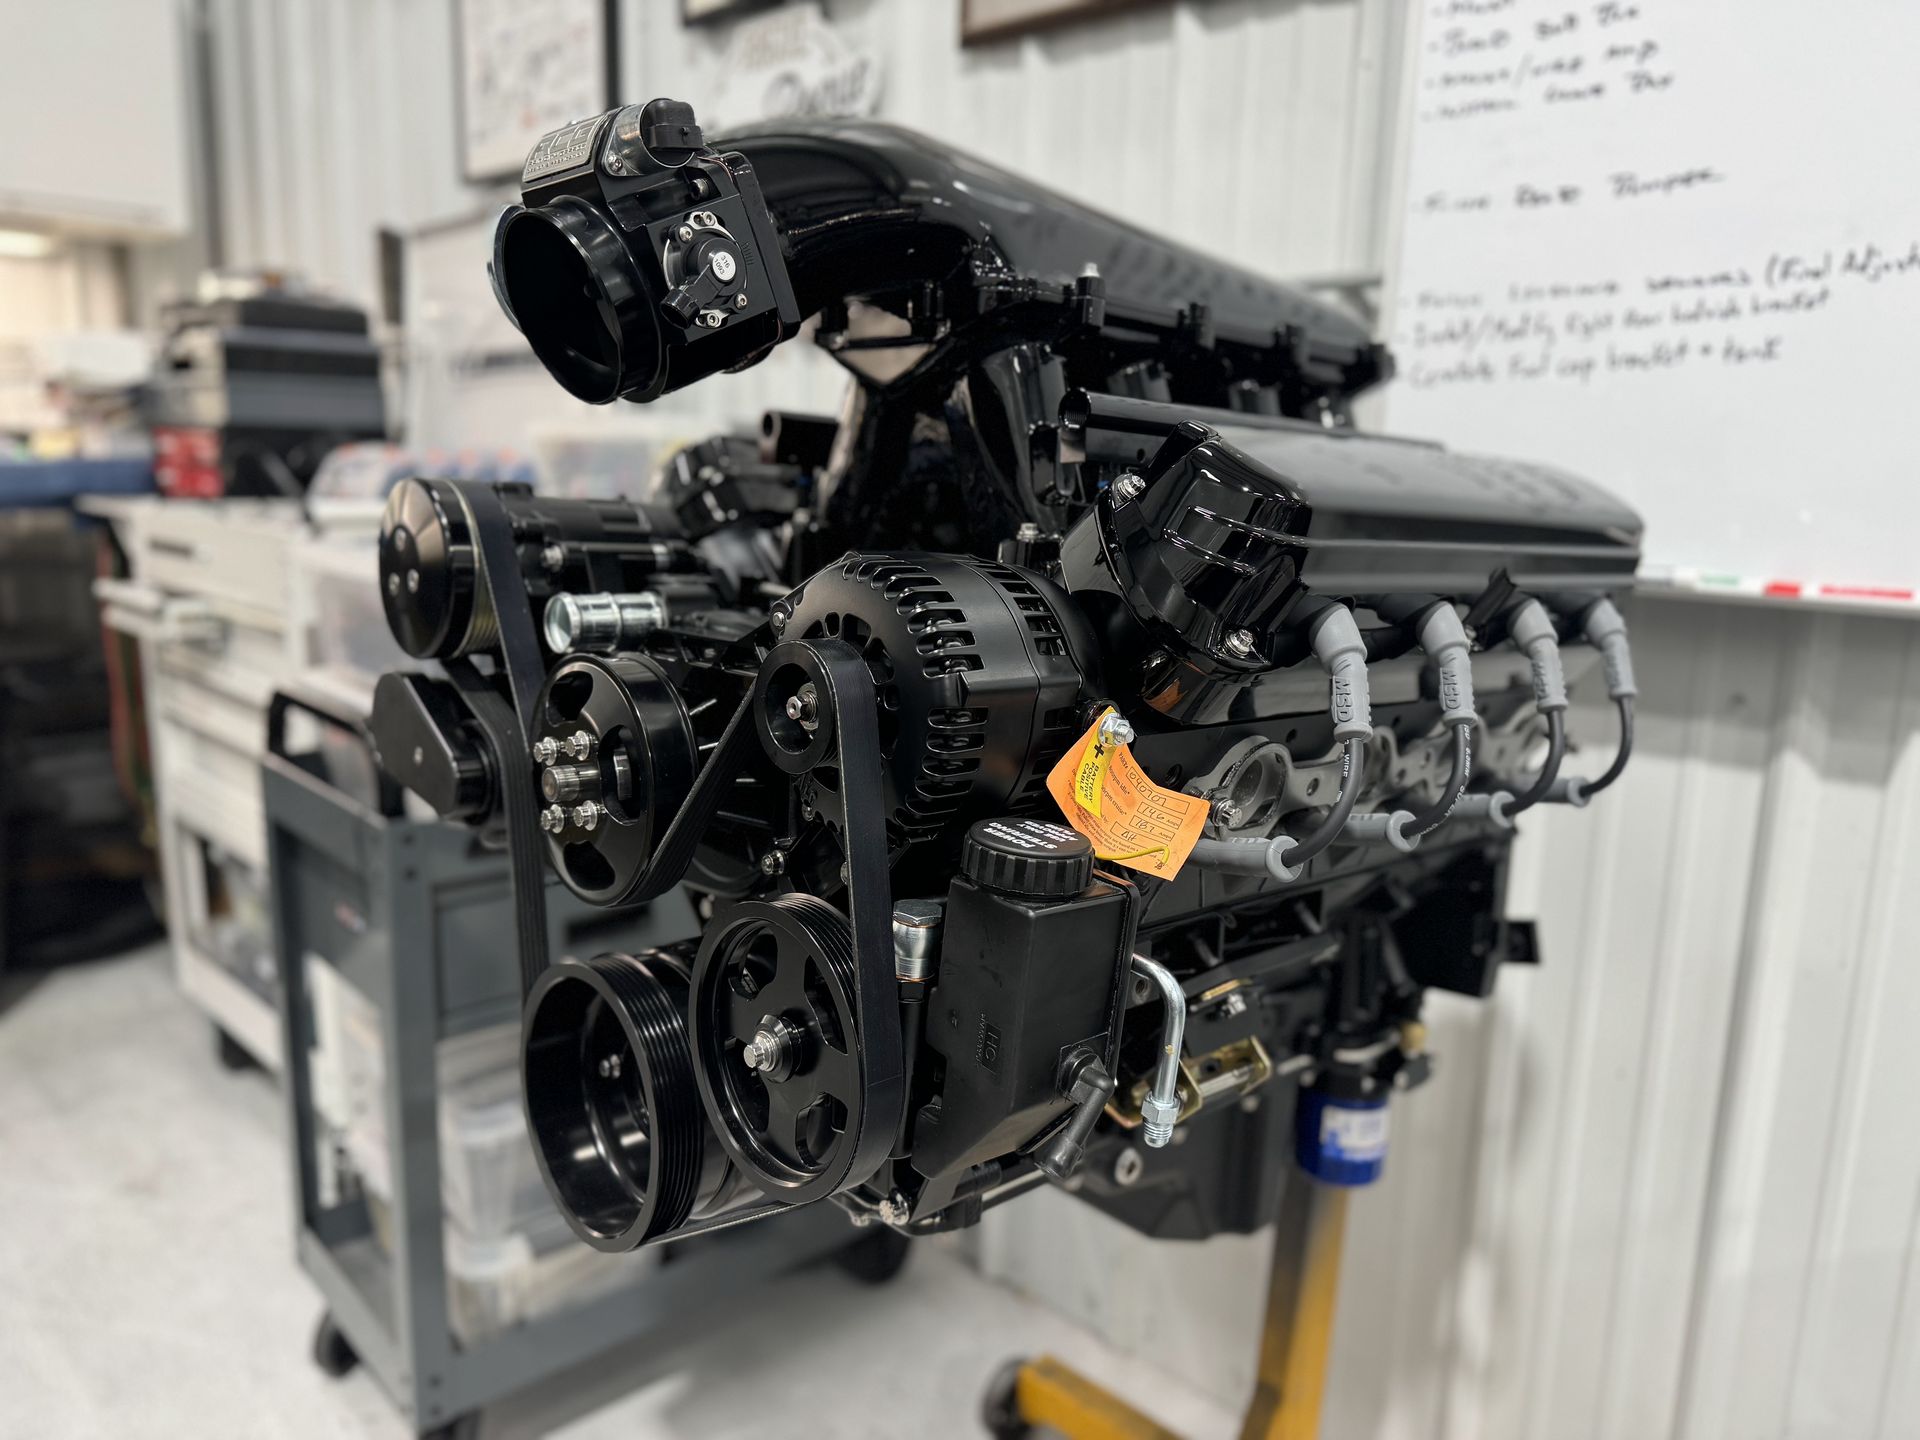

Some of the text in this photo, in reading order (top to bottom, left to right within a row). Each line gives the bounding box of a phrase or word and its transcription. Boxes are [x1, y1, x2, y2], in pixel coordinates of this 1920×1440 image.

[1335, 679, 1353, 722] MSD
[1443, 670, 1460, 710] MSD
[1080, 763, 1090, 792] CABLE
[1084, 761, 1096, 800] POSITIVE
[1089, 764, 1099, 803] BATTERY
[983, 827, 1036, 848] POWER
[989, 822, 1057, 849] STEERING
